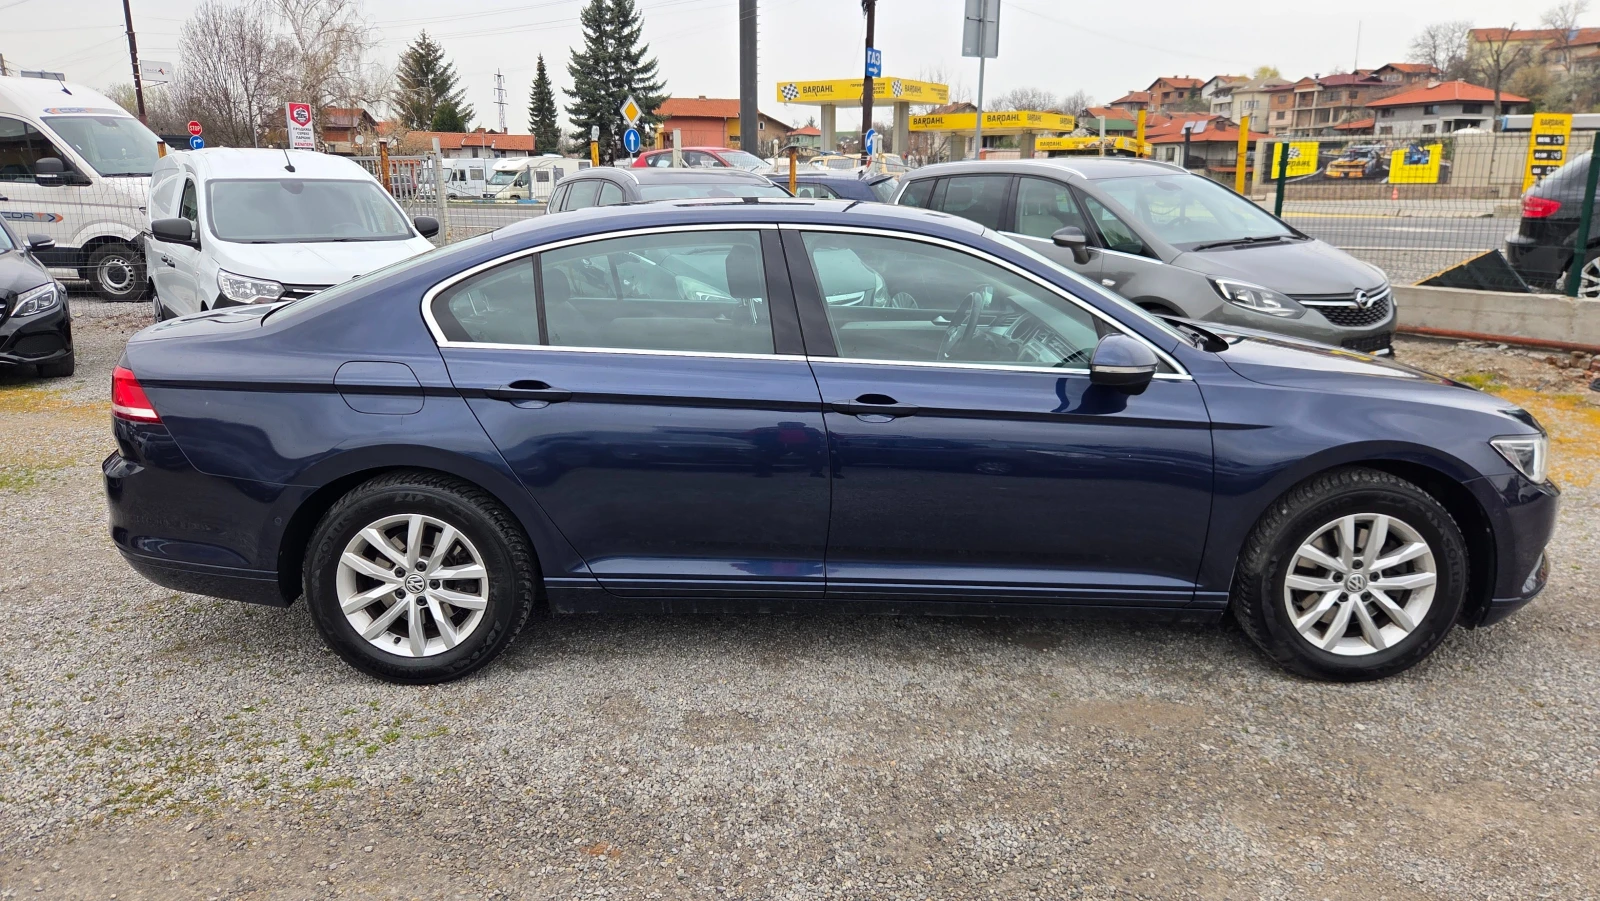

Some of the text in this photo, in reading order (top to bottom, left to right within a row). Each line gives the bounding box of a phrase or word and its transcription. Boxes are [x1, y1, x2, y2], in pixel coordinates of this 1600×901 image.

[867, 51, 880, 66] ГАЗ
[803, 84, 834, 97] BARDAHL
[913, 117, 945, 128] BARDAHL
[986, 113, 1021, 125] BARDAHL
